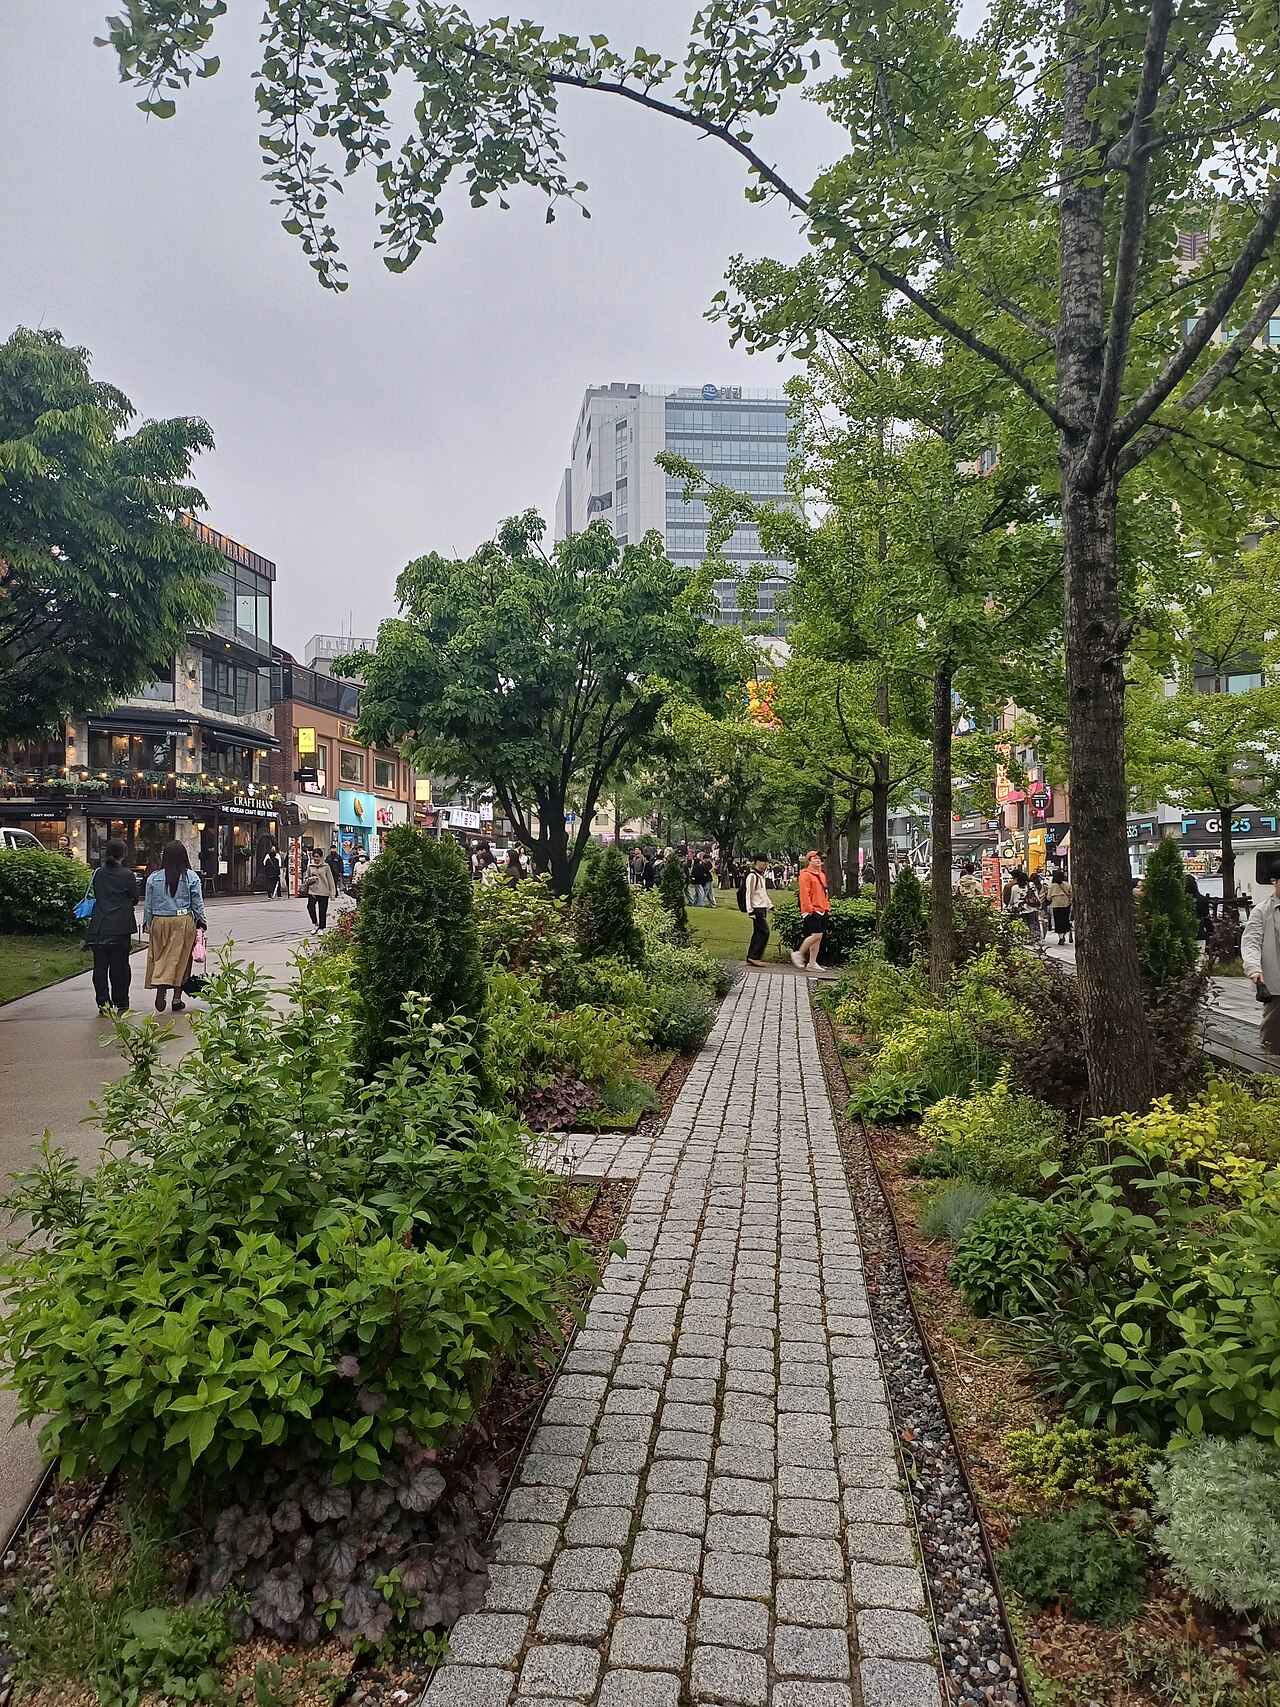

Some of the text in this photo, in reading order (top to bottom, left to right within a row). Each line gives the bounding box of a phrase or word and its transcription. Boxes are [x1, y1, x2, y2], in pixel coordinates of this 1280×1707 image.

[227, 542, 250, 567] HANS
[234, 796, 274, 810] CRAFT HANS
